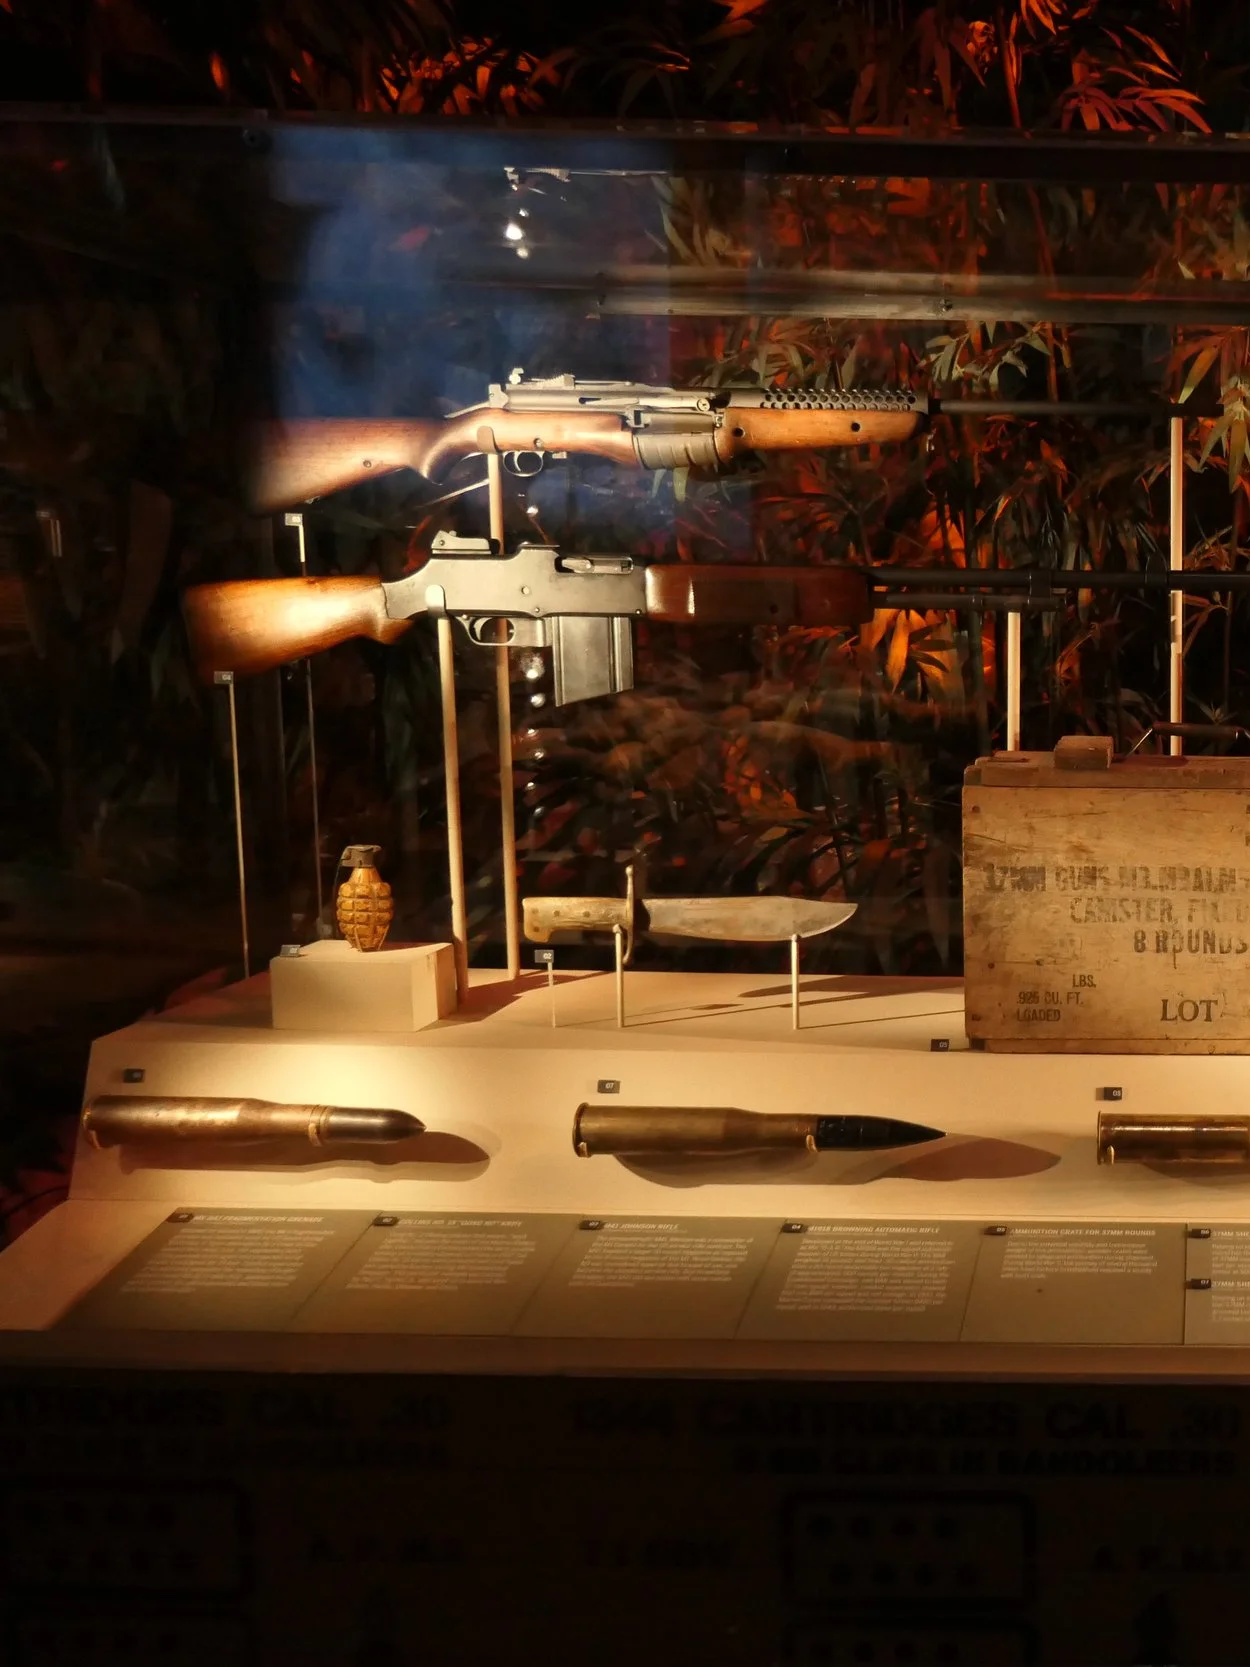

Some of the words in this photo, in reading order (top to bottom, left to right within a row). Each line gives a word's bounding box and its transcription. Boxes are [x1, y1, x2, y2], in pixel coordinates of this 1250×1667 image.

[1134, 930, 1147, 953] 8
[1155, 930, 1249, 955] ROUNDS
[1160, 998, 1219, 1023] LOT
[1044, 1402, 1145, 1440] CAL
